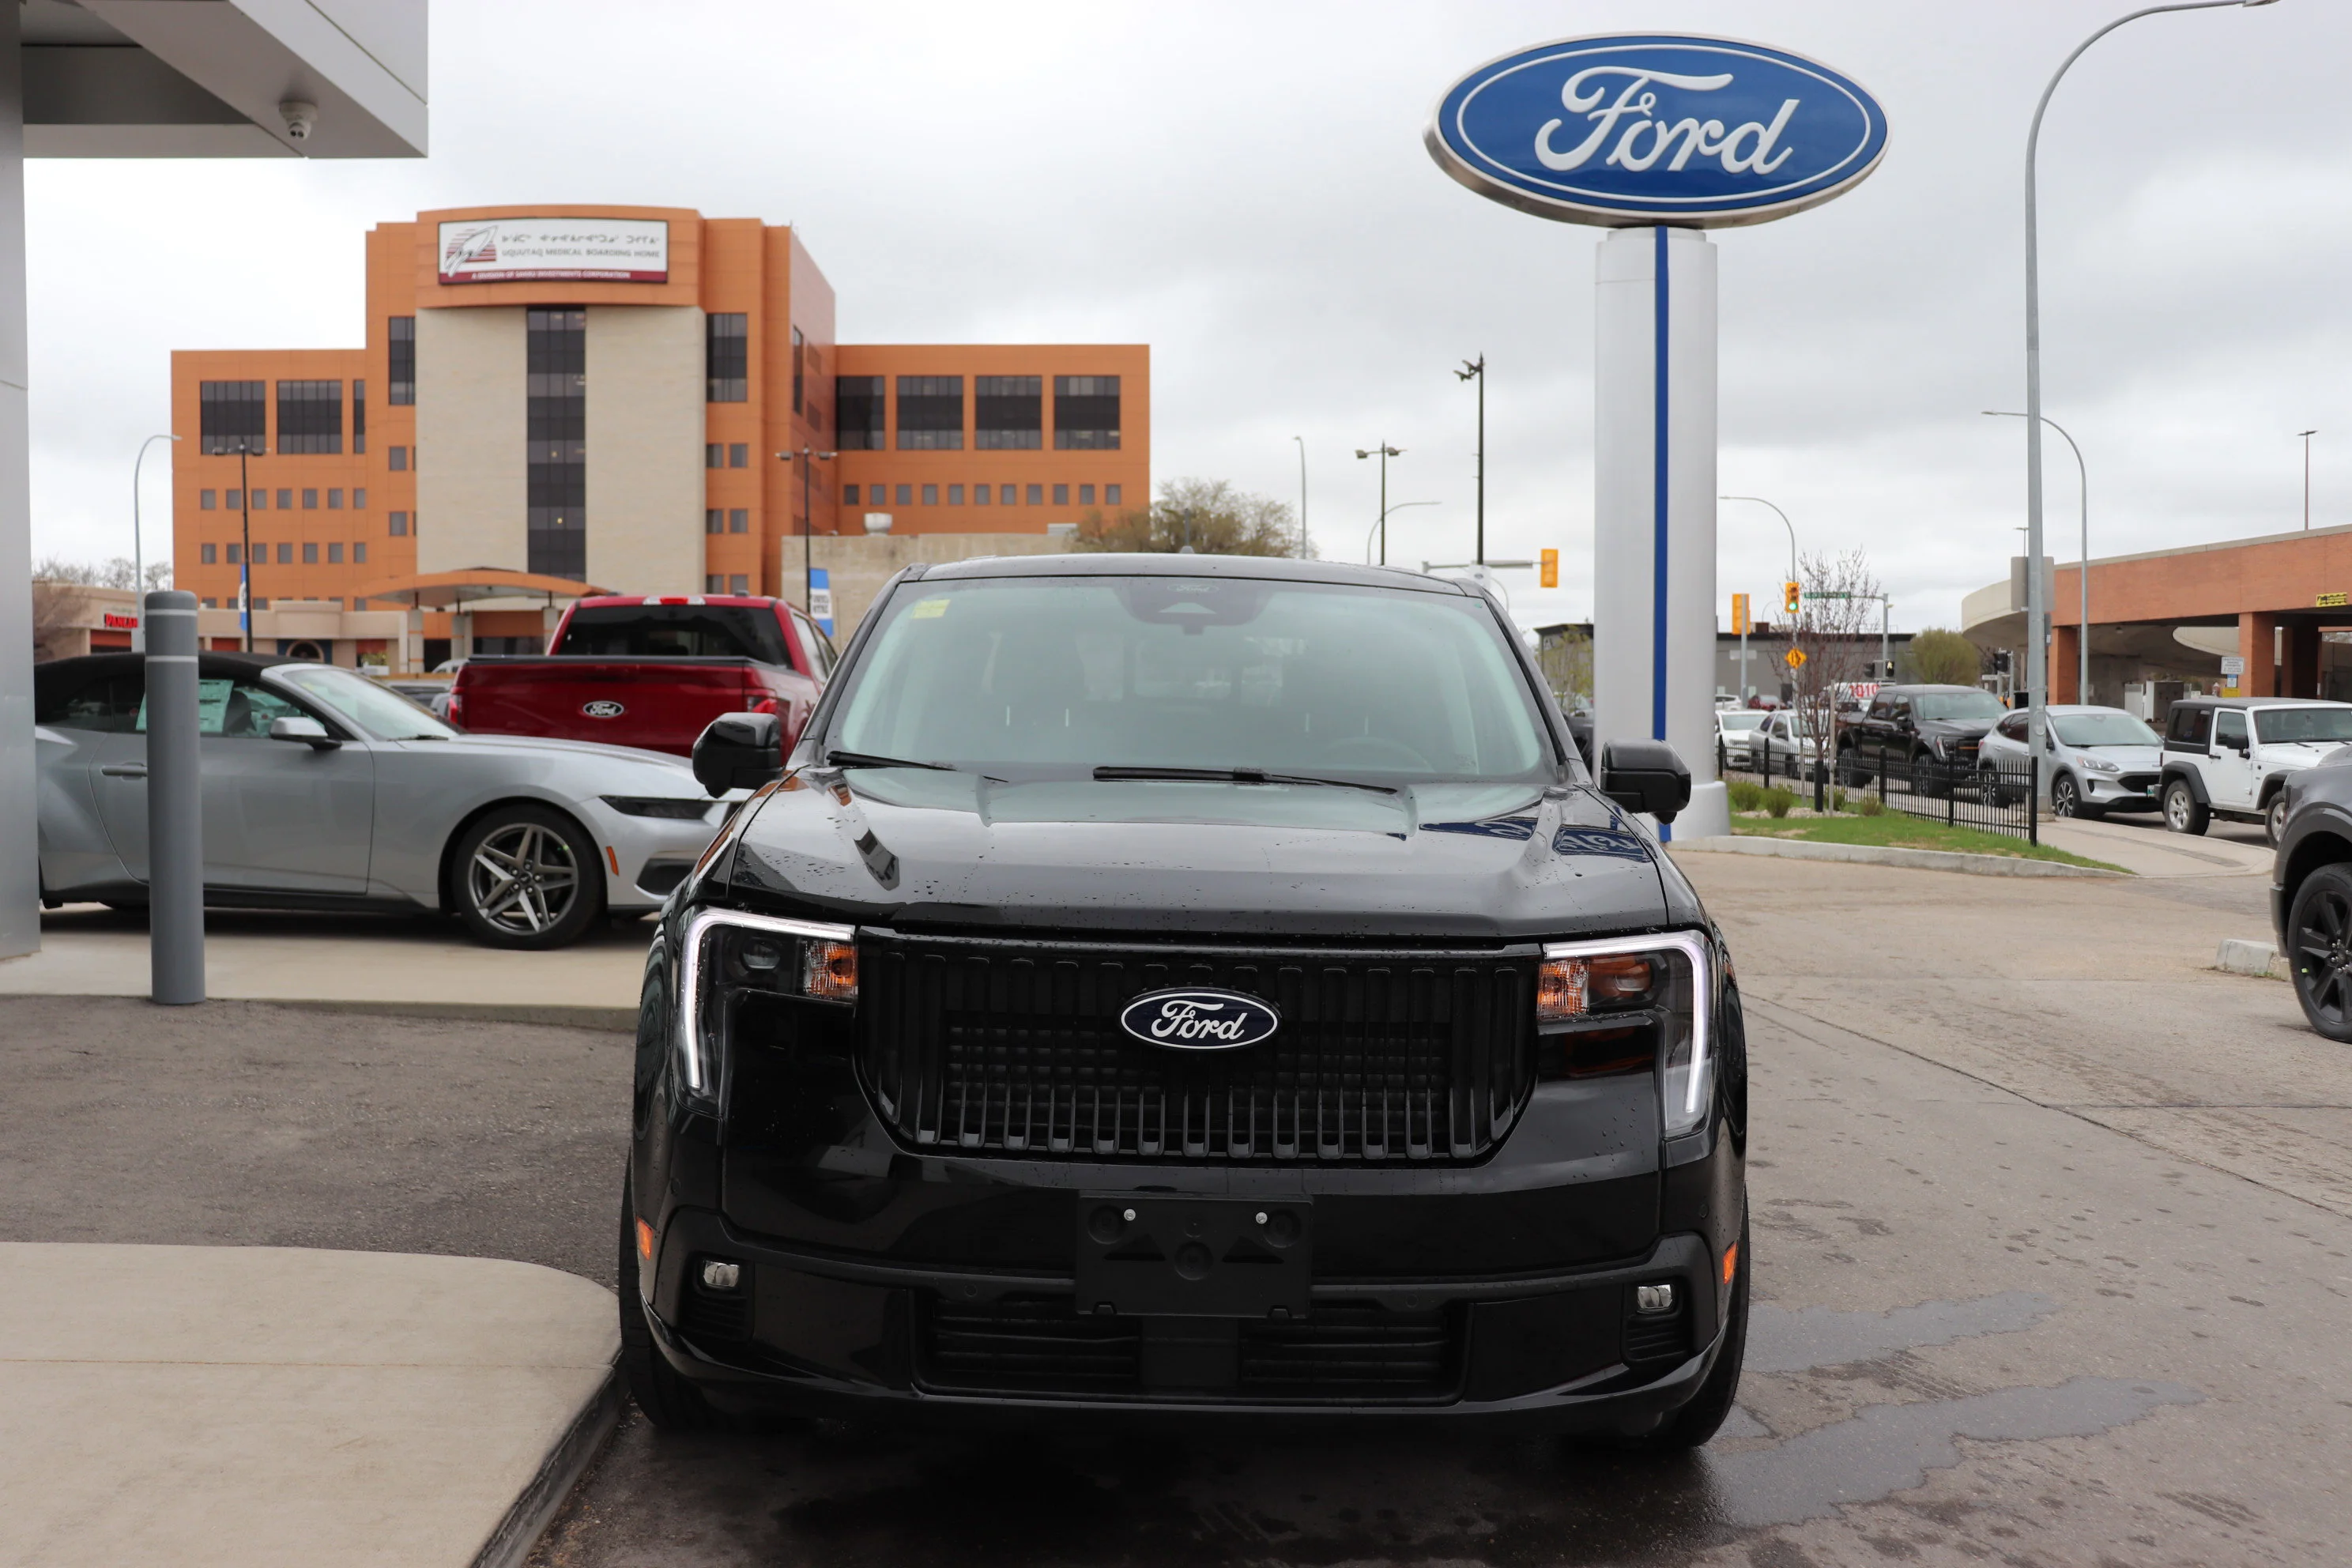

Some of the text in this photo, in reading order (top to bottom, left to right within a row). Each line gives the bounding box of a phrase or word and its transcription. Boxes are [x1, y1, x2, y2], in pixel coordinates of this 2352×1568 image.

[1535, 66, 1800, 175] Ford
[586, 248, 631, 257] BOARDING
[1151, 1000, 1248, 1040] Ford
